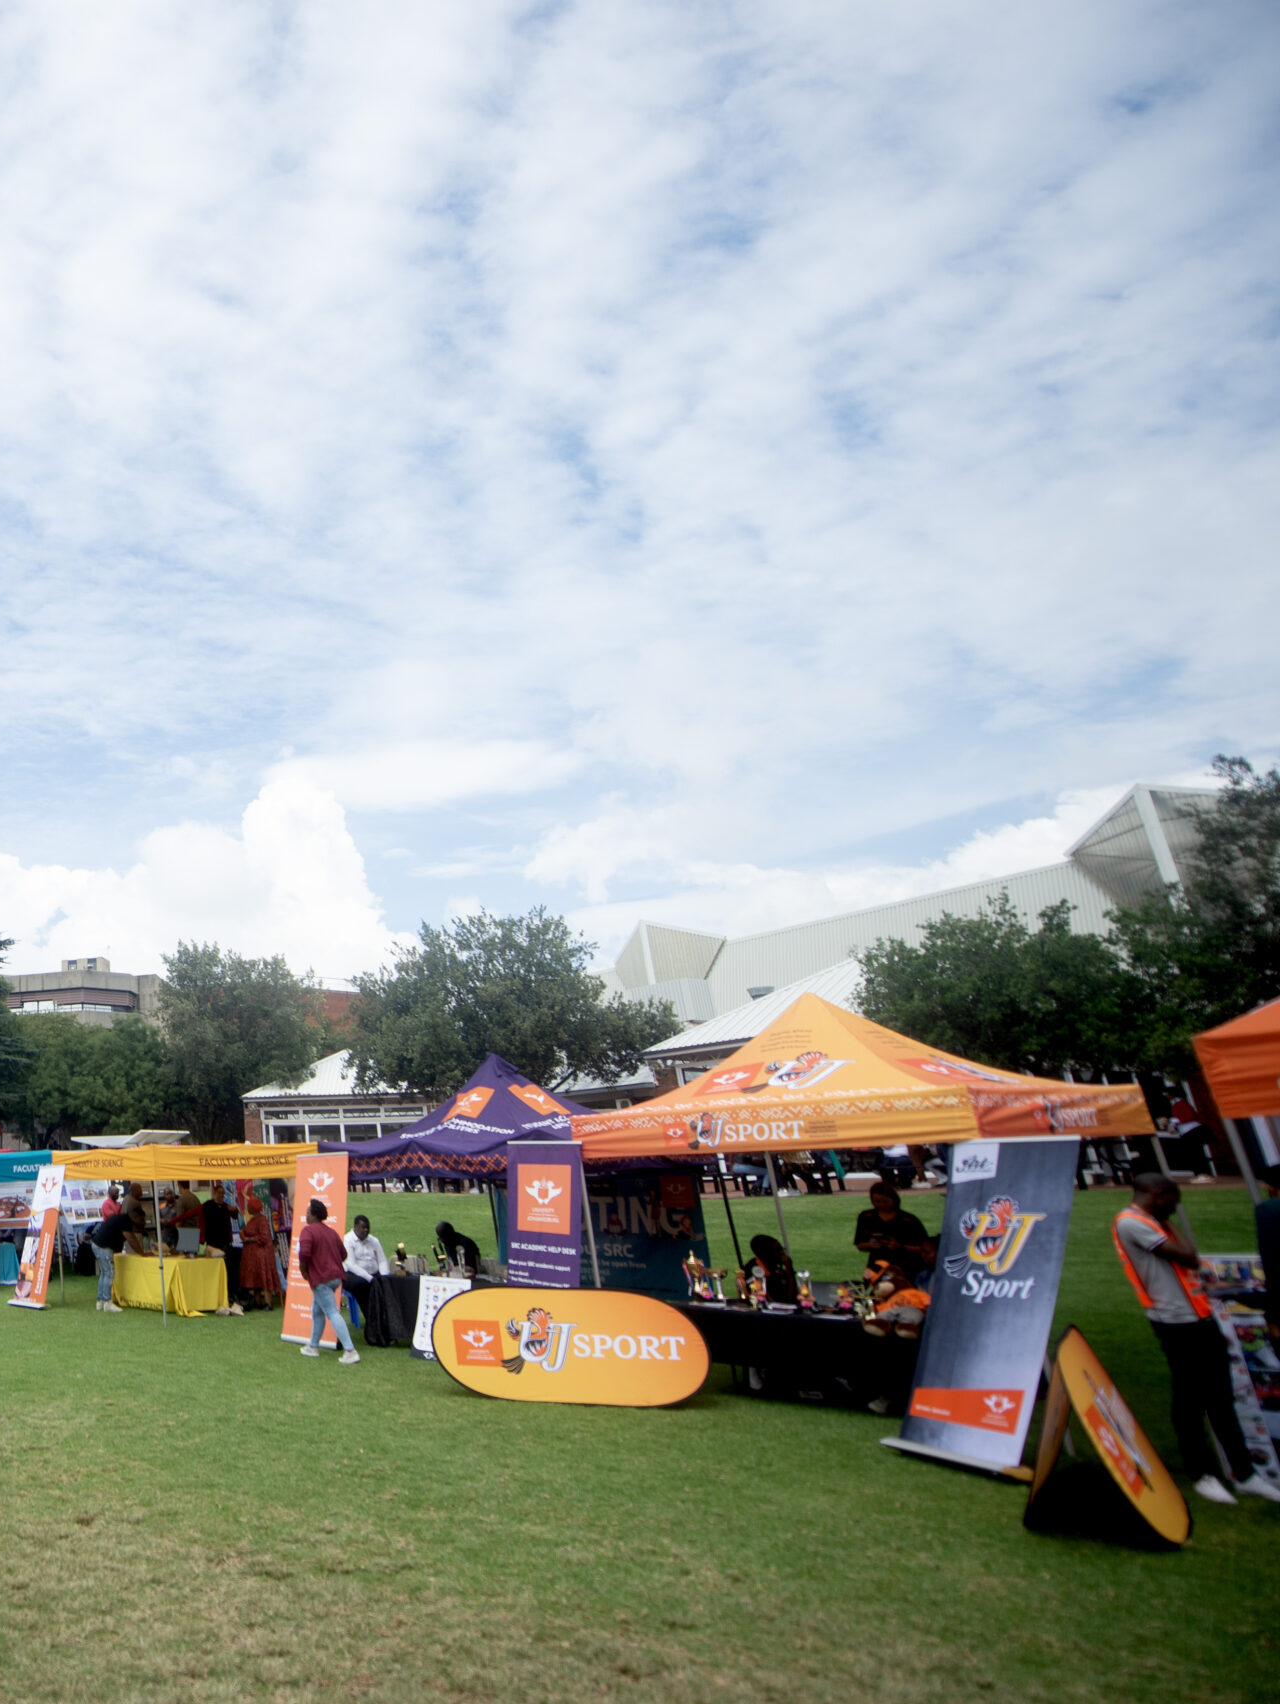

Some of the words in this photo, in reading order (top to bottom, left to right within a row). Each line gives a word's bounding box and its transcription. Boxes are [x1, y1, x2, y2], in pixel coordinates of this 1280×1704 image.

[1062, 1107, 1098, 1128] SPORT
[725, 1120, 804, 1143] SPORT
[101, 1158, 124, 1168] SCIENCE
[198, 1157, 238, 1167] FACULTY
[239, 1156, 251, 1167] OF
[253, 1155, 290, 1166] SCIENCE
[510, 1241, 521, 1250] SRC
[521, 1242, 548, 1253] ACADEMIC
[548, 1245, 562, 1254] HELP
[562, 1247, 577, 1256] DESK
[603, 1243, 635, 1259] SRC
[969, 1213, 1047, 1275] UJ
[961, 1270, 1036, 1304] Sport
[519, 1321, 578, 1373] UJ
[573, 1333, 685, 1361] SPORT
